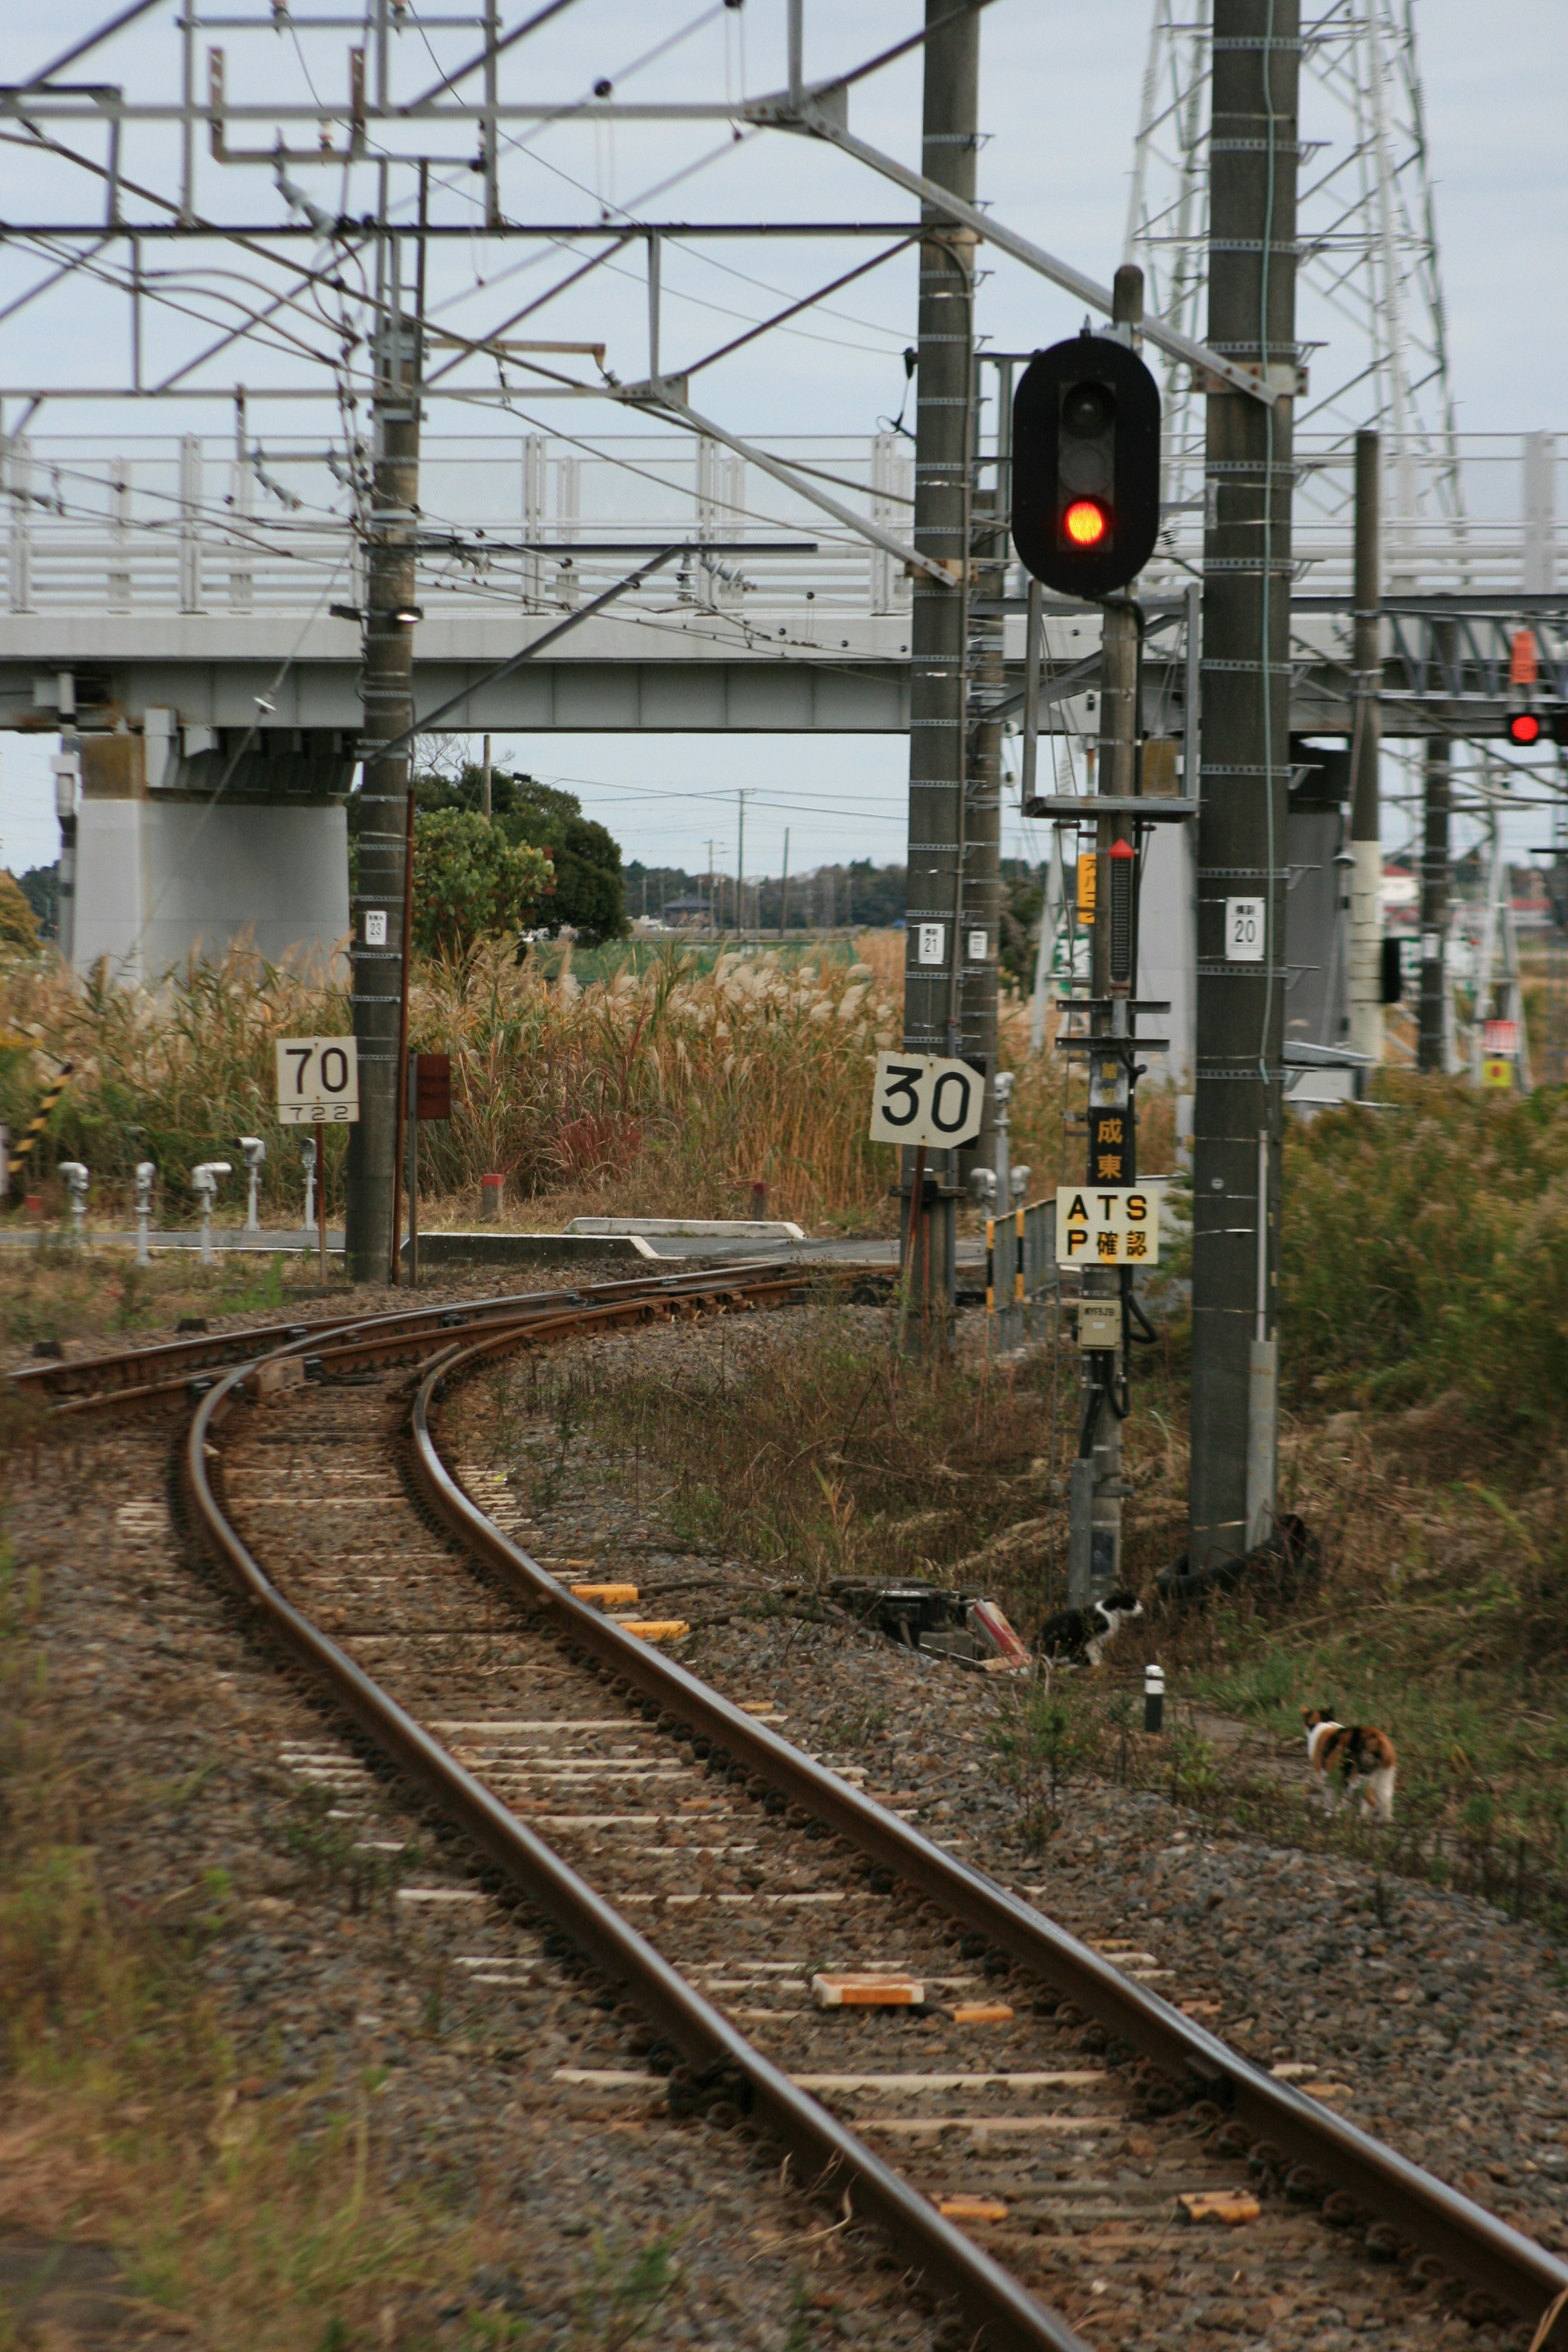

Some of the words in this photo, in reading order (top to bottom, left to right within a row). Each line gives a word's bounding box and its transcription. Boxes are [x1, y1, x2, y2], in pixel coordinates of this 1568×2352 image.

[370, 923, 382, 935] 23
[1235, 920, 1256, 942] 20
[925, 938, 937, 953] 21
[286, 1047, 348, 1094] 70
[881, 1065, 970, 1132] 30
[289, 1106, 348, 1121] 722
[1097, 1118, 1123, 1179] 成東
[1067, 1194, 1147, 1220] ATS
